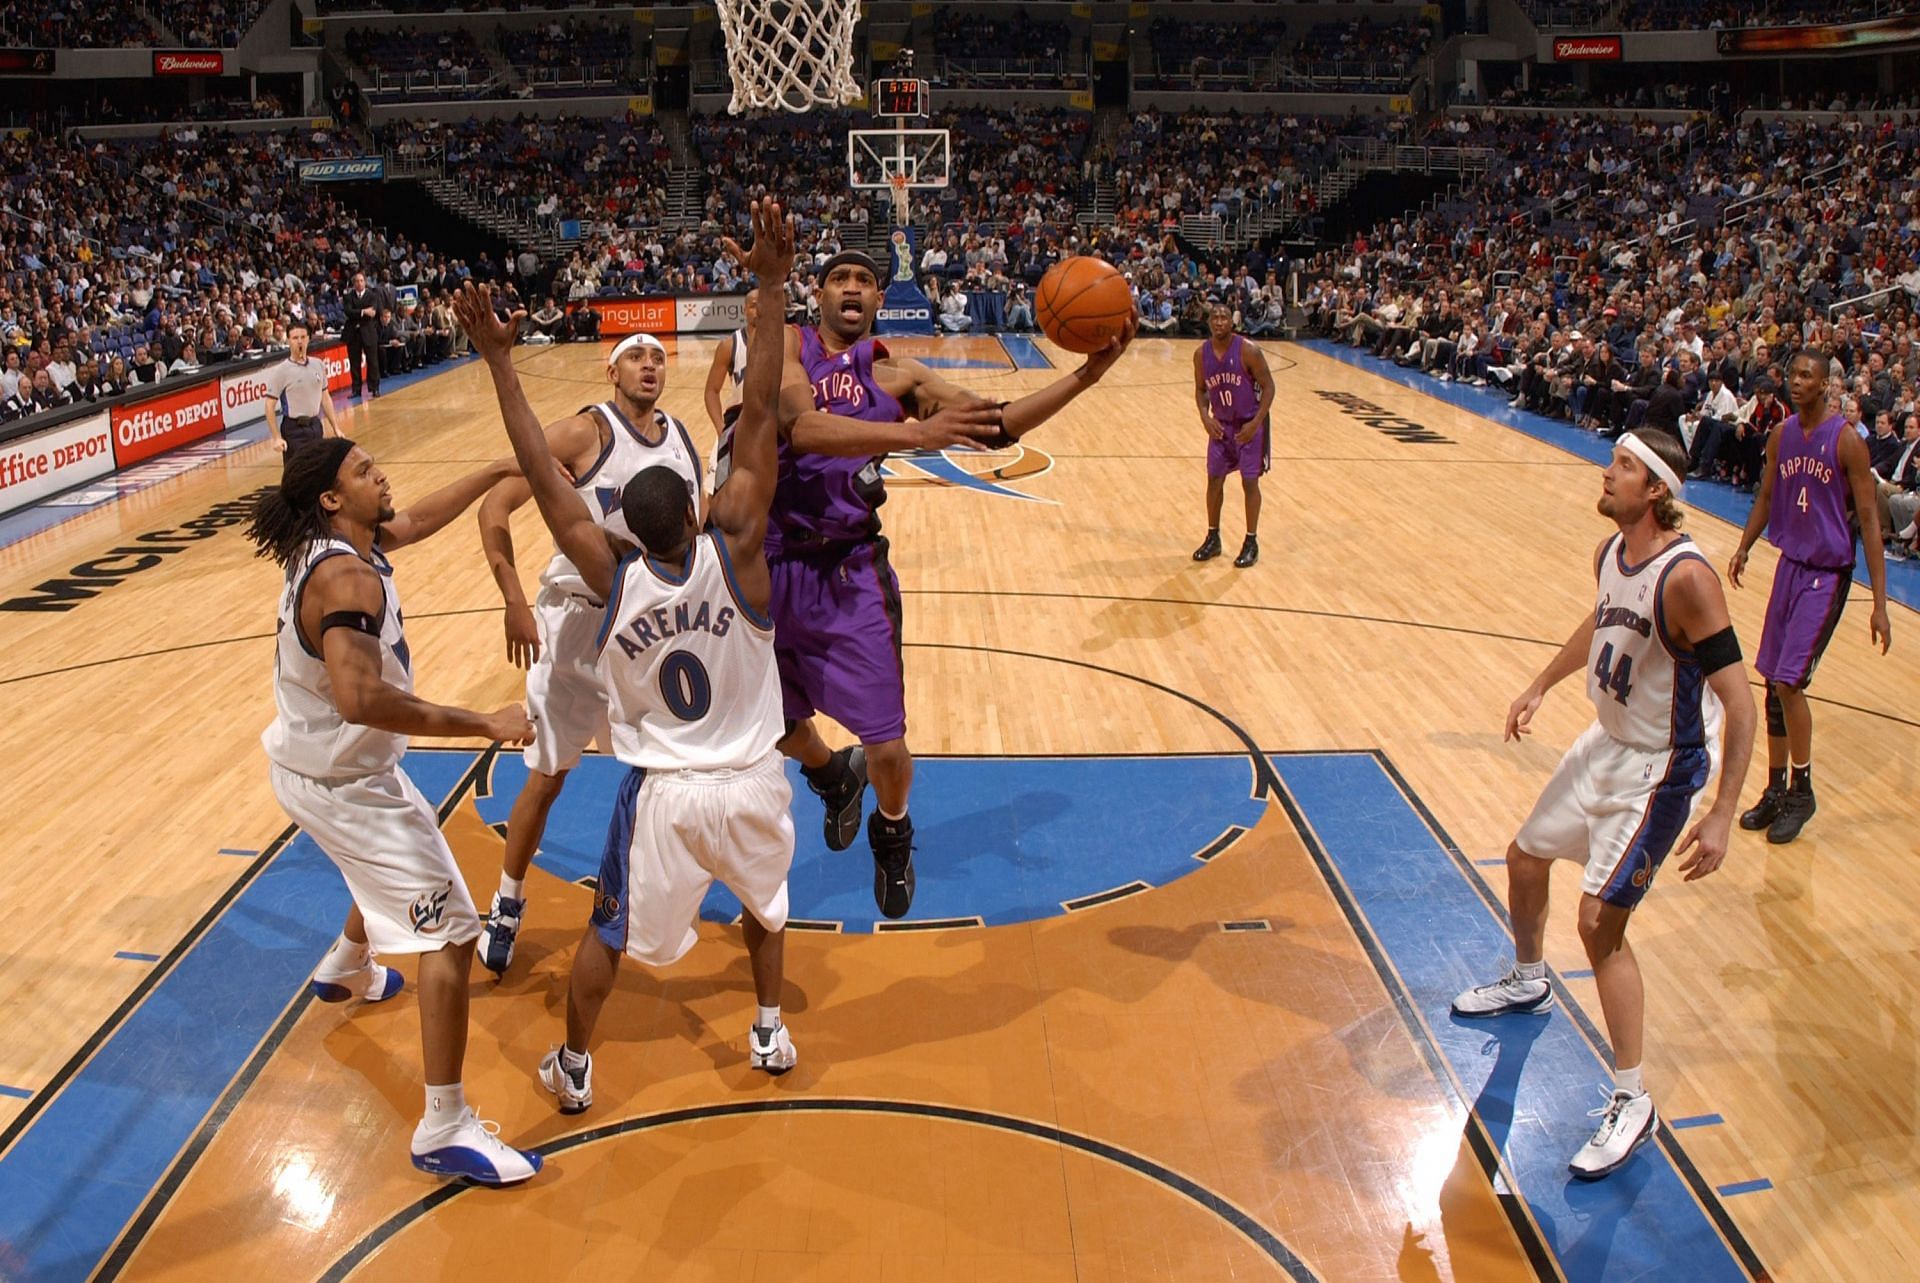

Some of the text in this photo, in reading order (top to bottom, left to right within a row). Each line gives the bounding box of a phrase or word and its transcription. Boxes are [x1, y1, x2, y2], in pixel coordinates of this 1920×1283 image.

[160, 56, 218, 70] Budweiser
[1557, 43, 1614, 57] Budweiser
[302, 163, 381, 176] BUD LIGHT
[601, 303, 664, 325] ingular
[876, 309, 929, 320] GEICO
[226, 379, 267, 408] Office
[1219, 390, 1233, 407] 10
[118, 397, 219, 447] Office DEPOT
[0, 452, 49, 490] ffice
[53, 433, 108, 470] DEPOT
[1780, 456, 1832, 484] RAPTORS
[1796, 486, 1808, 513] 4
[0, 546, 190, 612] MCI
[615, 600, 735, 661] ARENAS
[658, 649, 712, 722] 0
[1594, 640, 1633, 708] 44
